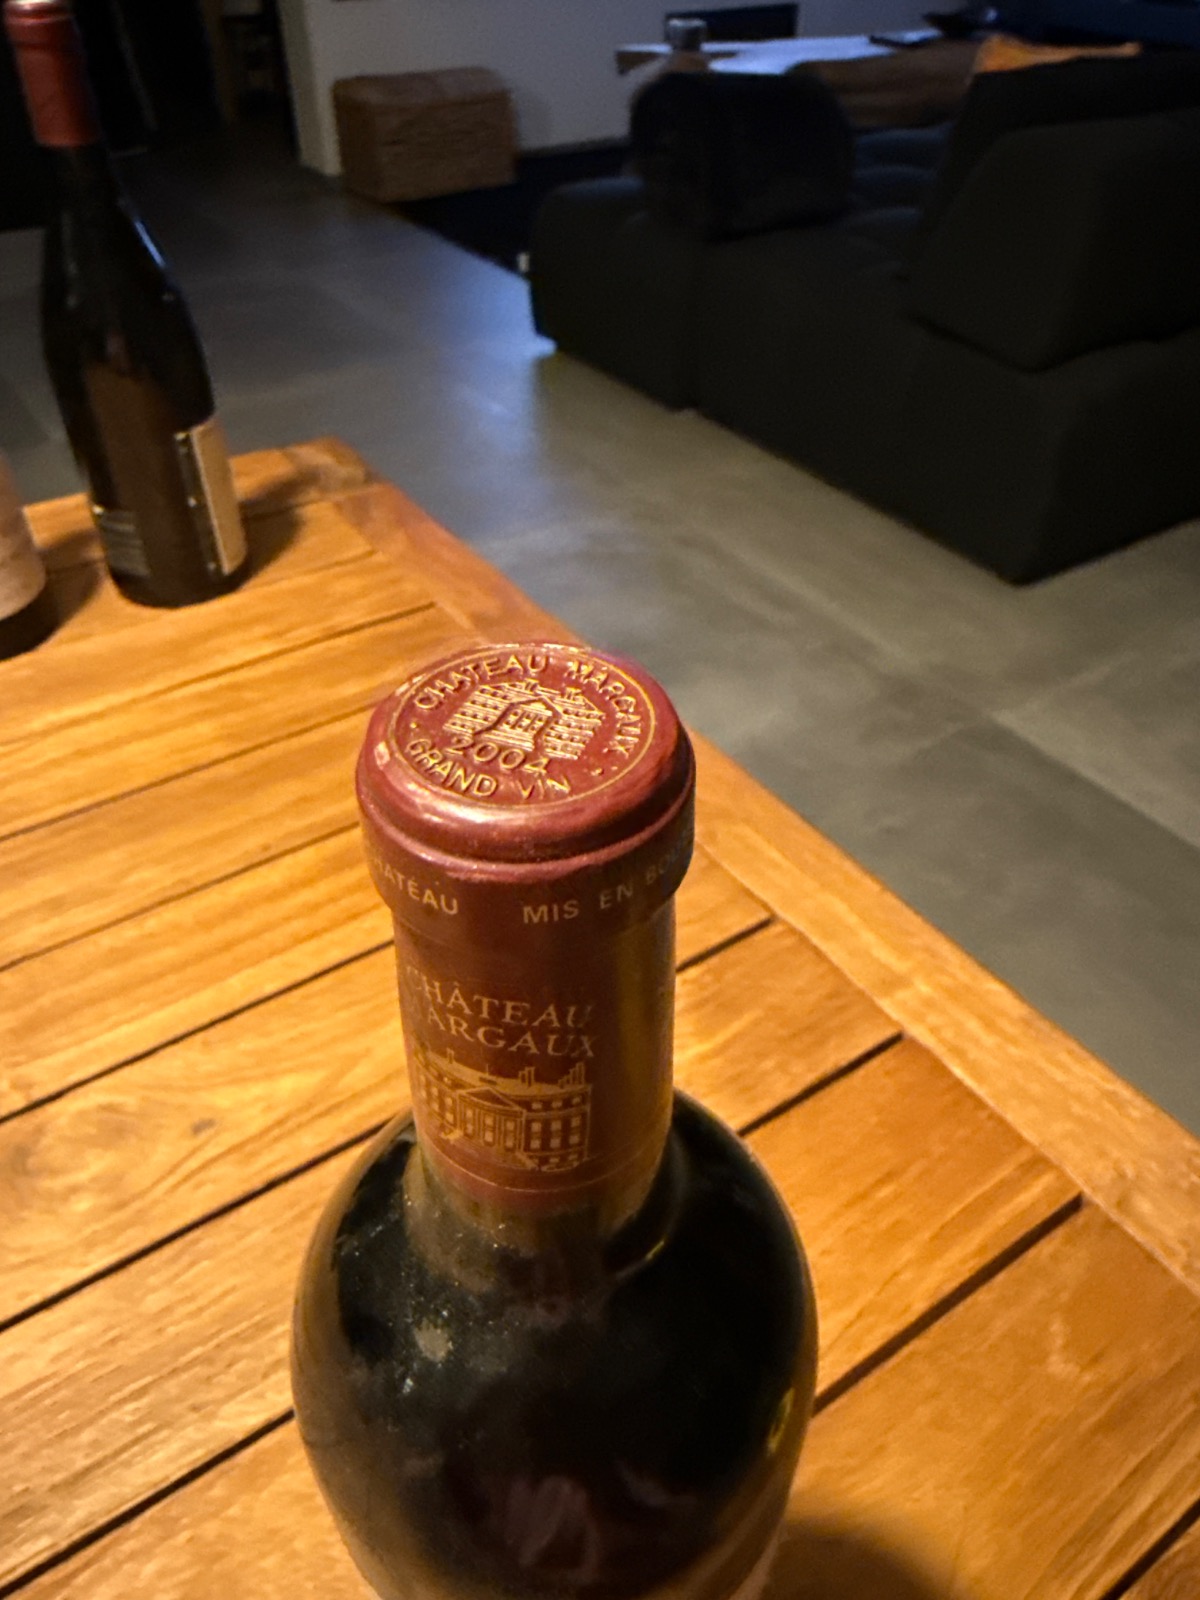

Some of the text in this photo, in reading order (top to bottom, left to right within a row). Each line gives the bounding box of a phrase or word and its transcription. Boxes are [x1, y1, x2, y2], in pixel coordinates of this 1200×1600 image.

[414, 653, 642, 758] CHATEAU MARGAUX
[406, 740, 571, 800] GRAND VIN
[446, 735, 550, 774] 2004
[522, 899, 579, 925] MIS
[599, 880, 634, 910] EN
[427, 1006, 597, 1058] ARGAUX
